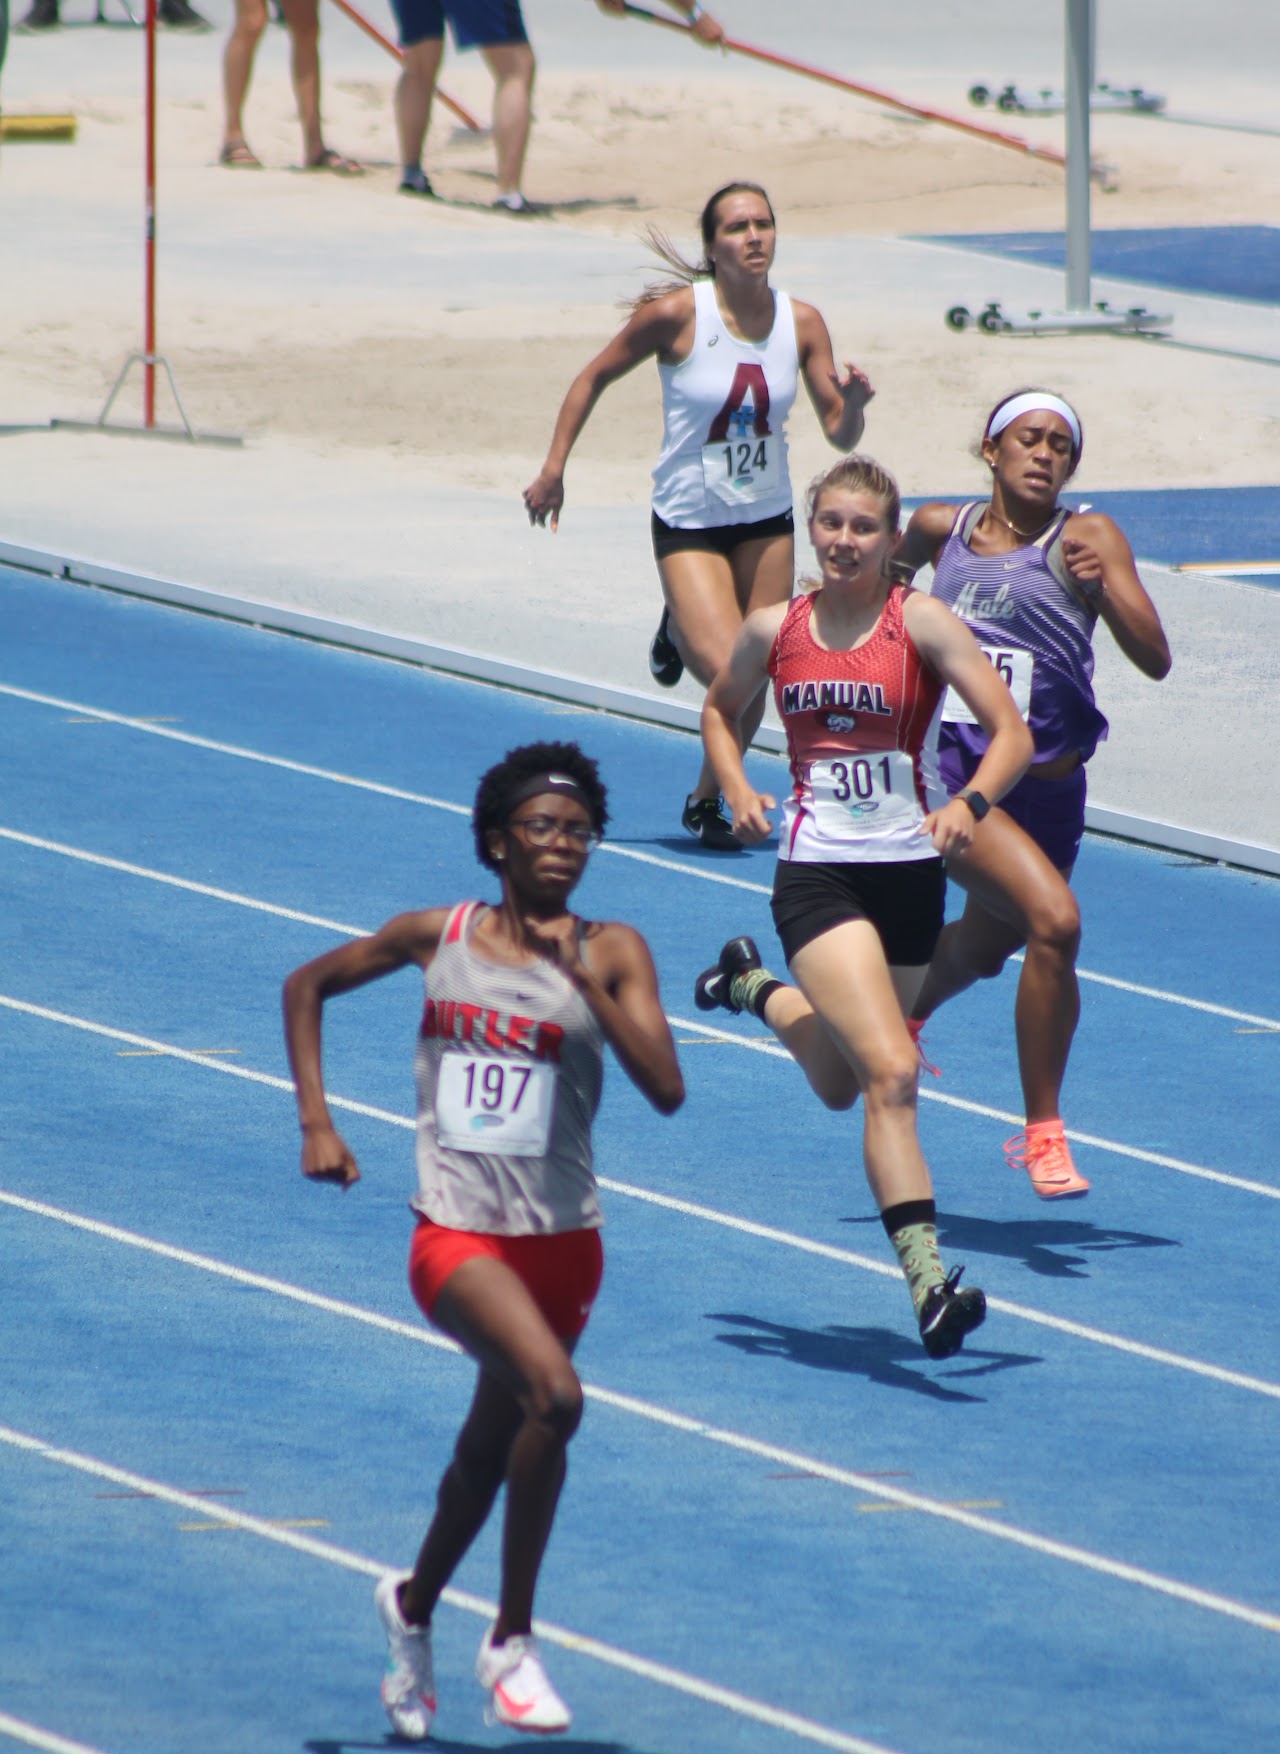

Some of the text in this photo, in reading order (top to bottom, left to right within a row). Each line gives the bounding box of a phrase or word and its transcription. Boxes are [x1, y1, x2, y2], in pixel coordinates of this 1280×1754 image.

[706, 363, 772, 443] A
[722, 440, 768, 478] 124
[952, 581, 1016, 620] Male
[983, 651, 1013, 689] 5
[783, 681, 893, 716] MANUAL
[831, 756, 891, 801] 301
[464, 1062, 533, 1113] 197
